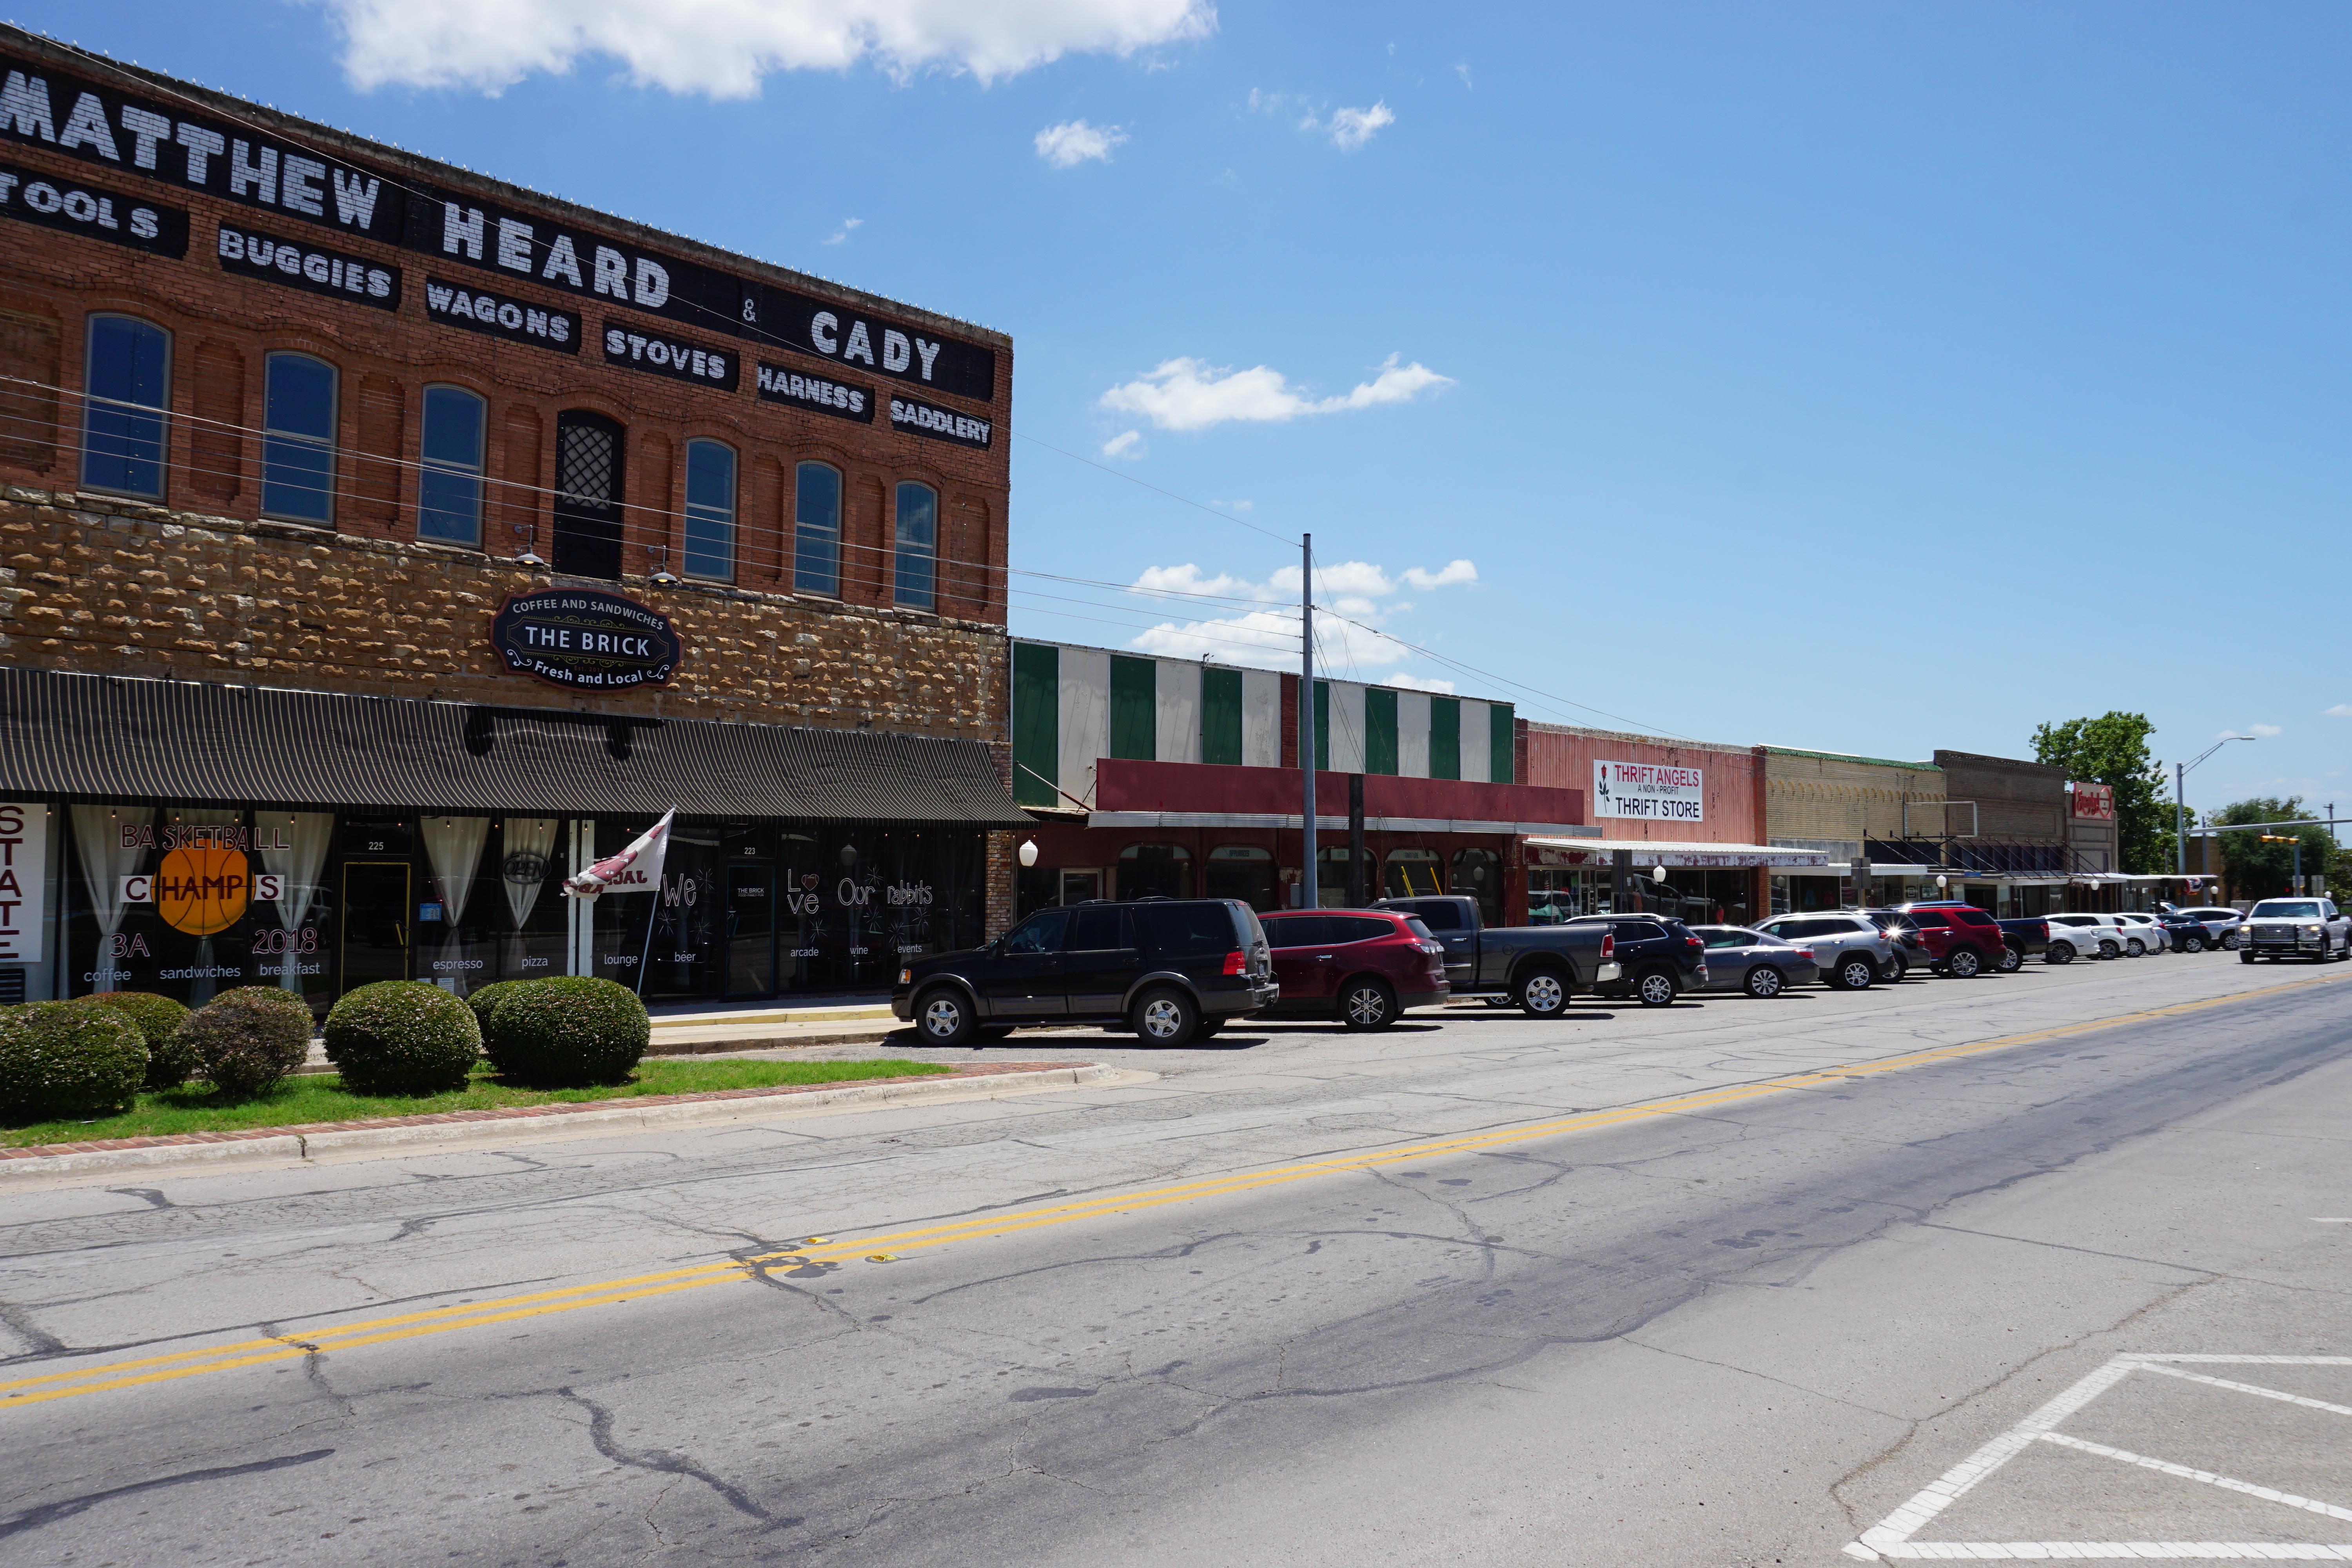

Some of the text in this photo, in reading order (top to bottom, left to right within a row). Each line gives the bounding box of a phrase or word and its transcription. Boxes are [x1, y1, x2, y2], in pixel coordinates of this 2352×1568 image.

[0, 70, 940, 380] MATTHEW HEARD & CADY
[219, 229, 391, 297] BUGGIES
[426, 283, 569, 342] WAGONS
[607, 330, 725, 379] STOVES
[758, 366, 864, 412] HARNESS
[891, 401, 990, 443] SADDLERY
[513, 599, 664, 630] COFFEE AND SANDWICHES
[526, 626, 649, 656] THE BRICK
[535, 661, 643, 684] Fresh and Local
[1615, 765, 1699, 787] THRIFT ANGELS
[1643, 785, 1655, 793] NON
[1660, 786, 1679, 795] PROFIT
[1615, 797, 1699, 818] THRIFT STORE
[121, 824, 290, 851] BASKETBALL
[368, 841, 384, 850] 225
[504, 861, 547, 877] OPEN
[126, 875, 279, 901] CHAMPS
[663, 873, 697, 907] We
[838, 878, 933, 906] Our rabbits
[110, 927, 318, 958] 3A 2018
[84, 944, 922, 982] coffee sandwiches breakfast espresso pizza lounge beer arcade wine events
